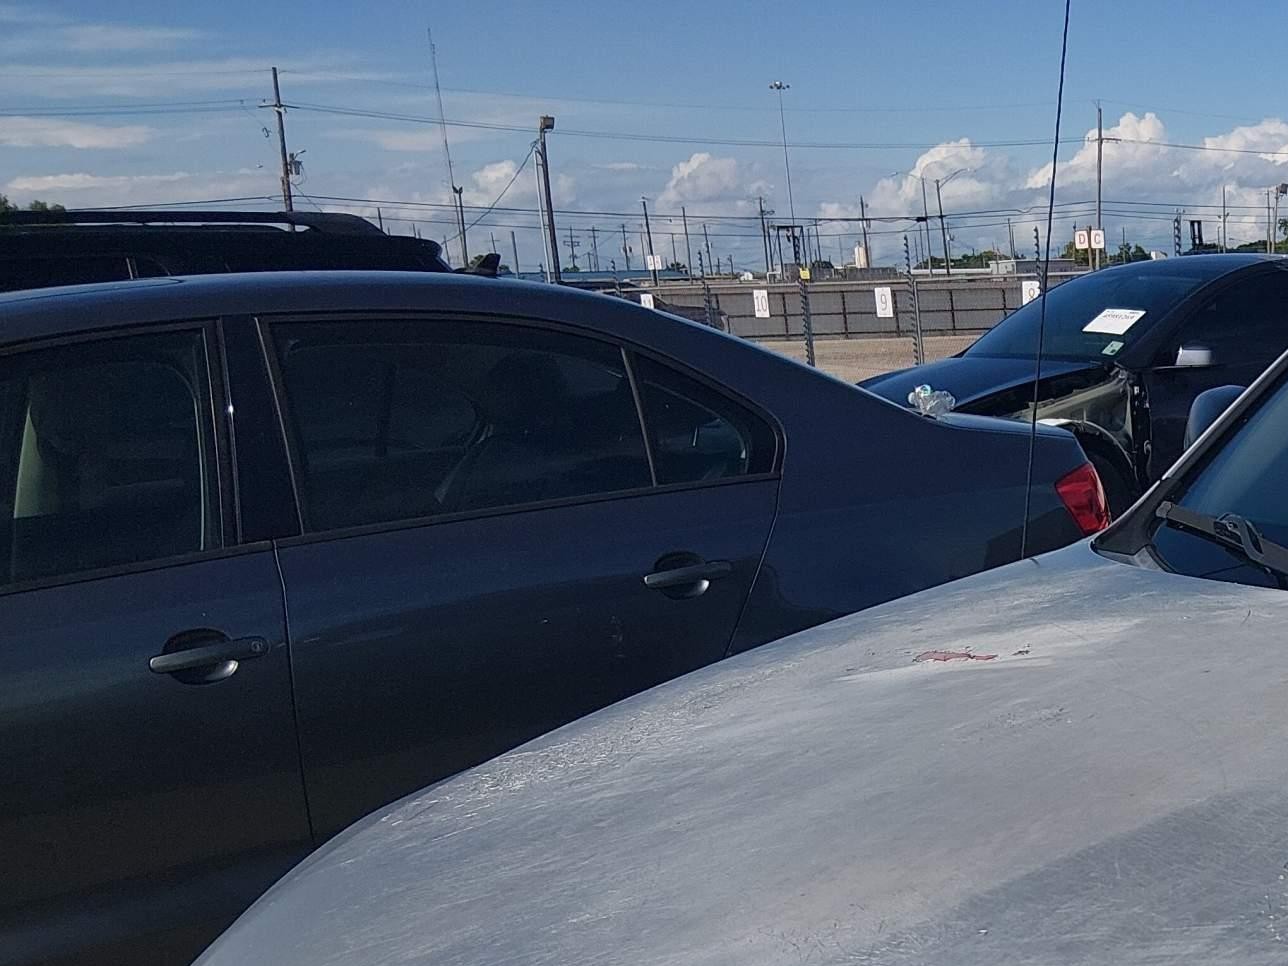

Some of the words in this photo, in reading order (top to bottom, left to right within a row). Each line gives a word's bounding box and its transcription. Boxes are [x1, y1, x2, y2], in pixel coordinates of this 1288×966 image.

[1078, 233, 1086, 245] D
[1094, 233, 1101, 245] C
[755, 295, 768, 312] 10
[880, 293, 888, 311] 9
